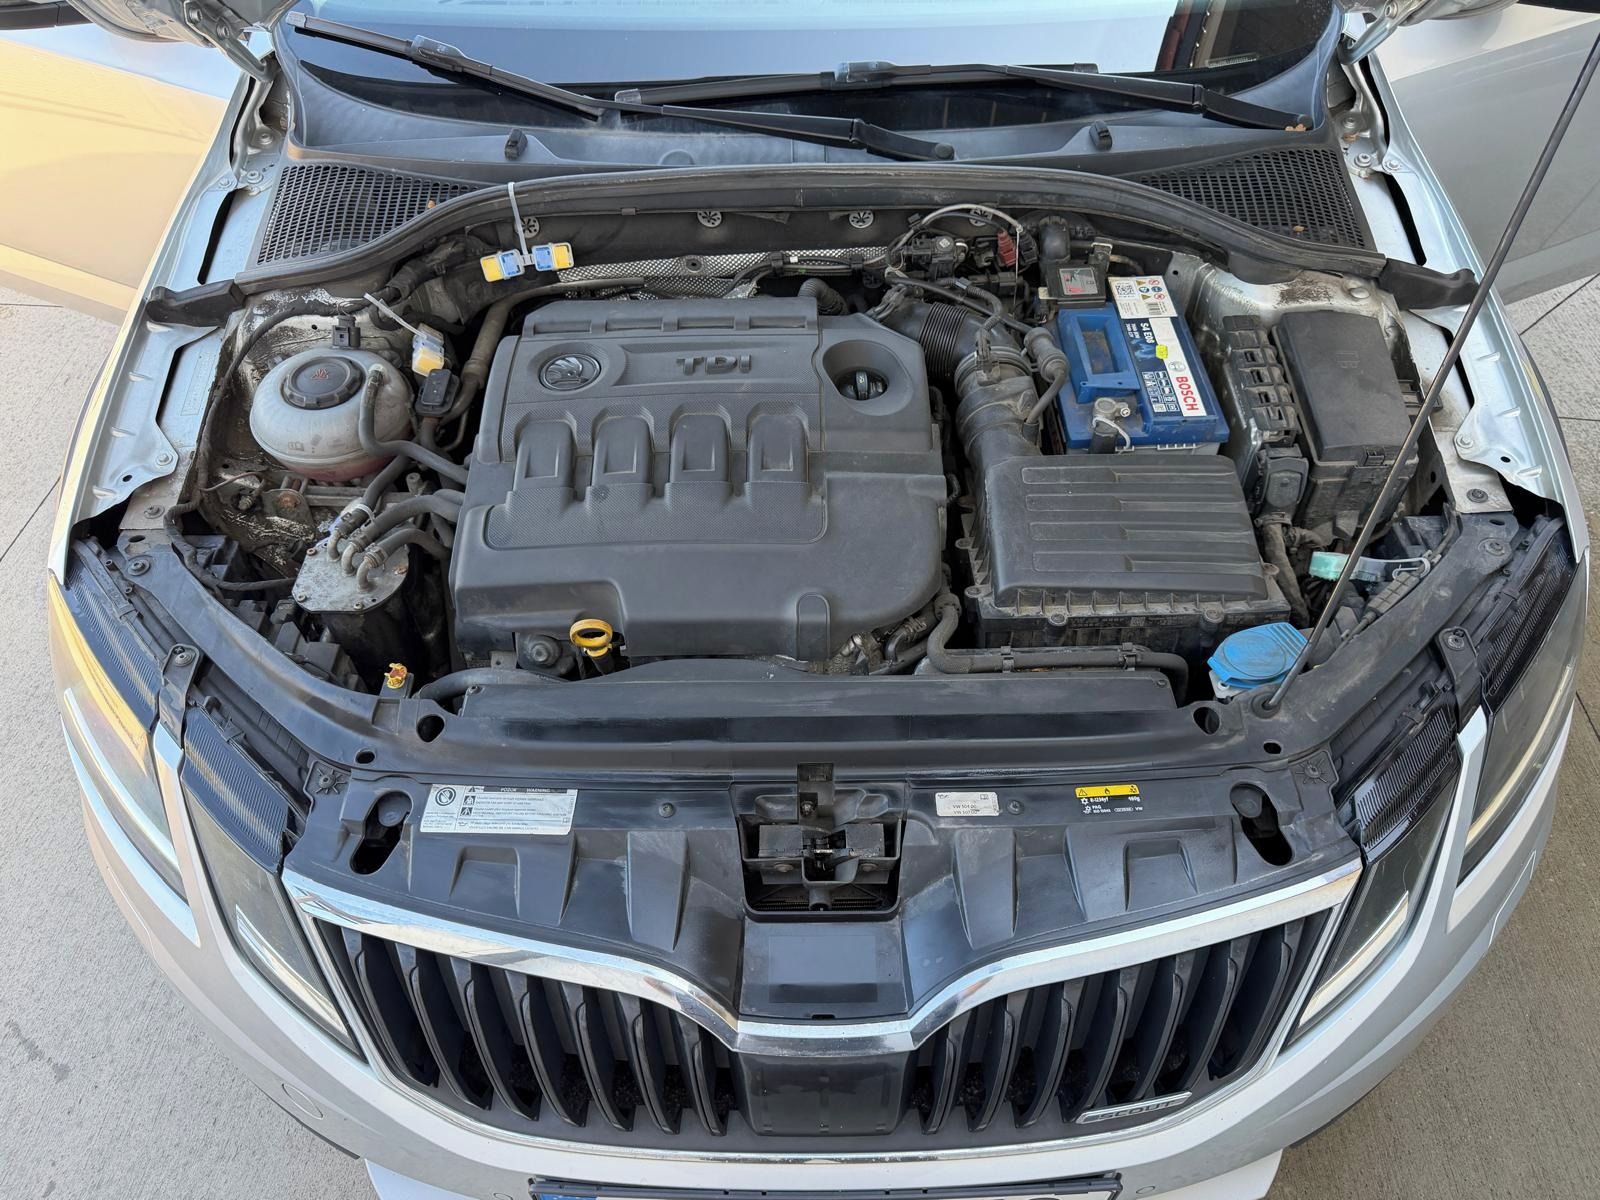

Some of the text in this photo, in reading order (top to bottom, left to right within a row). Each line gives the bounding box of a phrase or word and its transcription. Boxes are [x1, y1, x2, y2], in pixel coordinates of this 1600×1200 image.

[1140, 323, 1151, 334] S4
[676, 354, 752, 376] TDI
[1176, 376, 1199, 411] BOSCH
[1097, 1100, 1177, 1120] SCOUT
